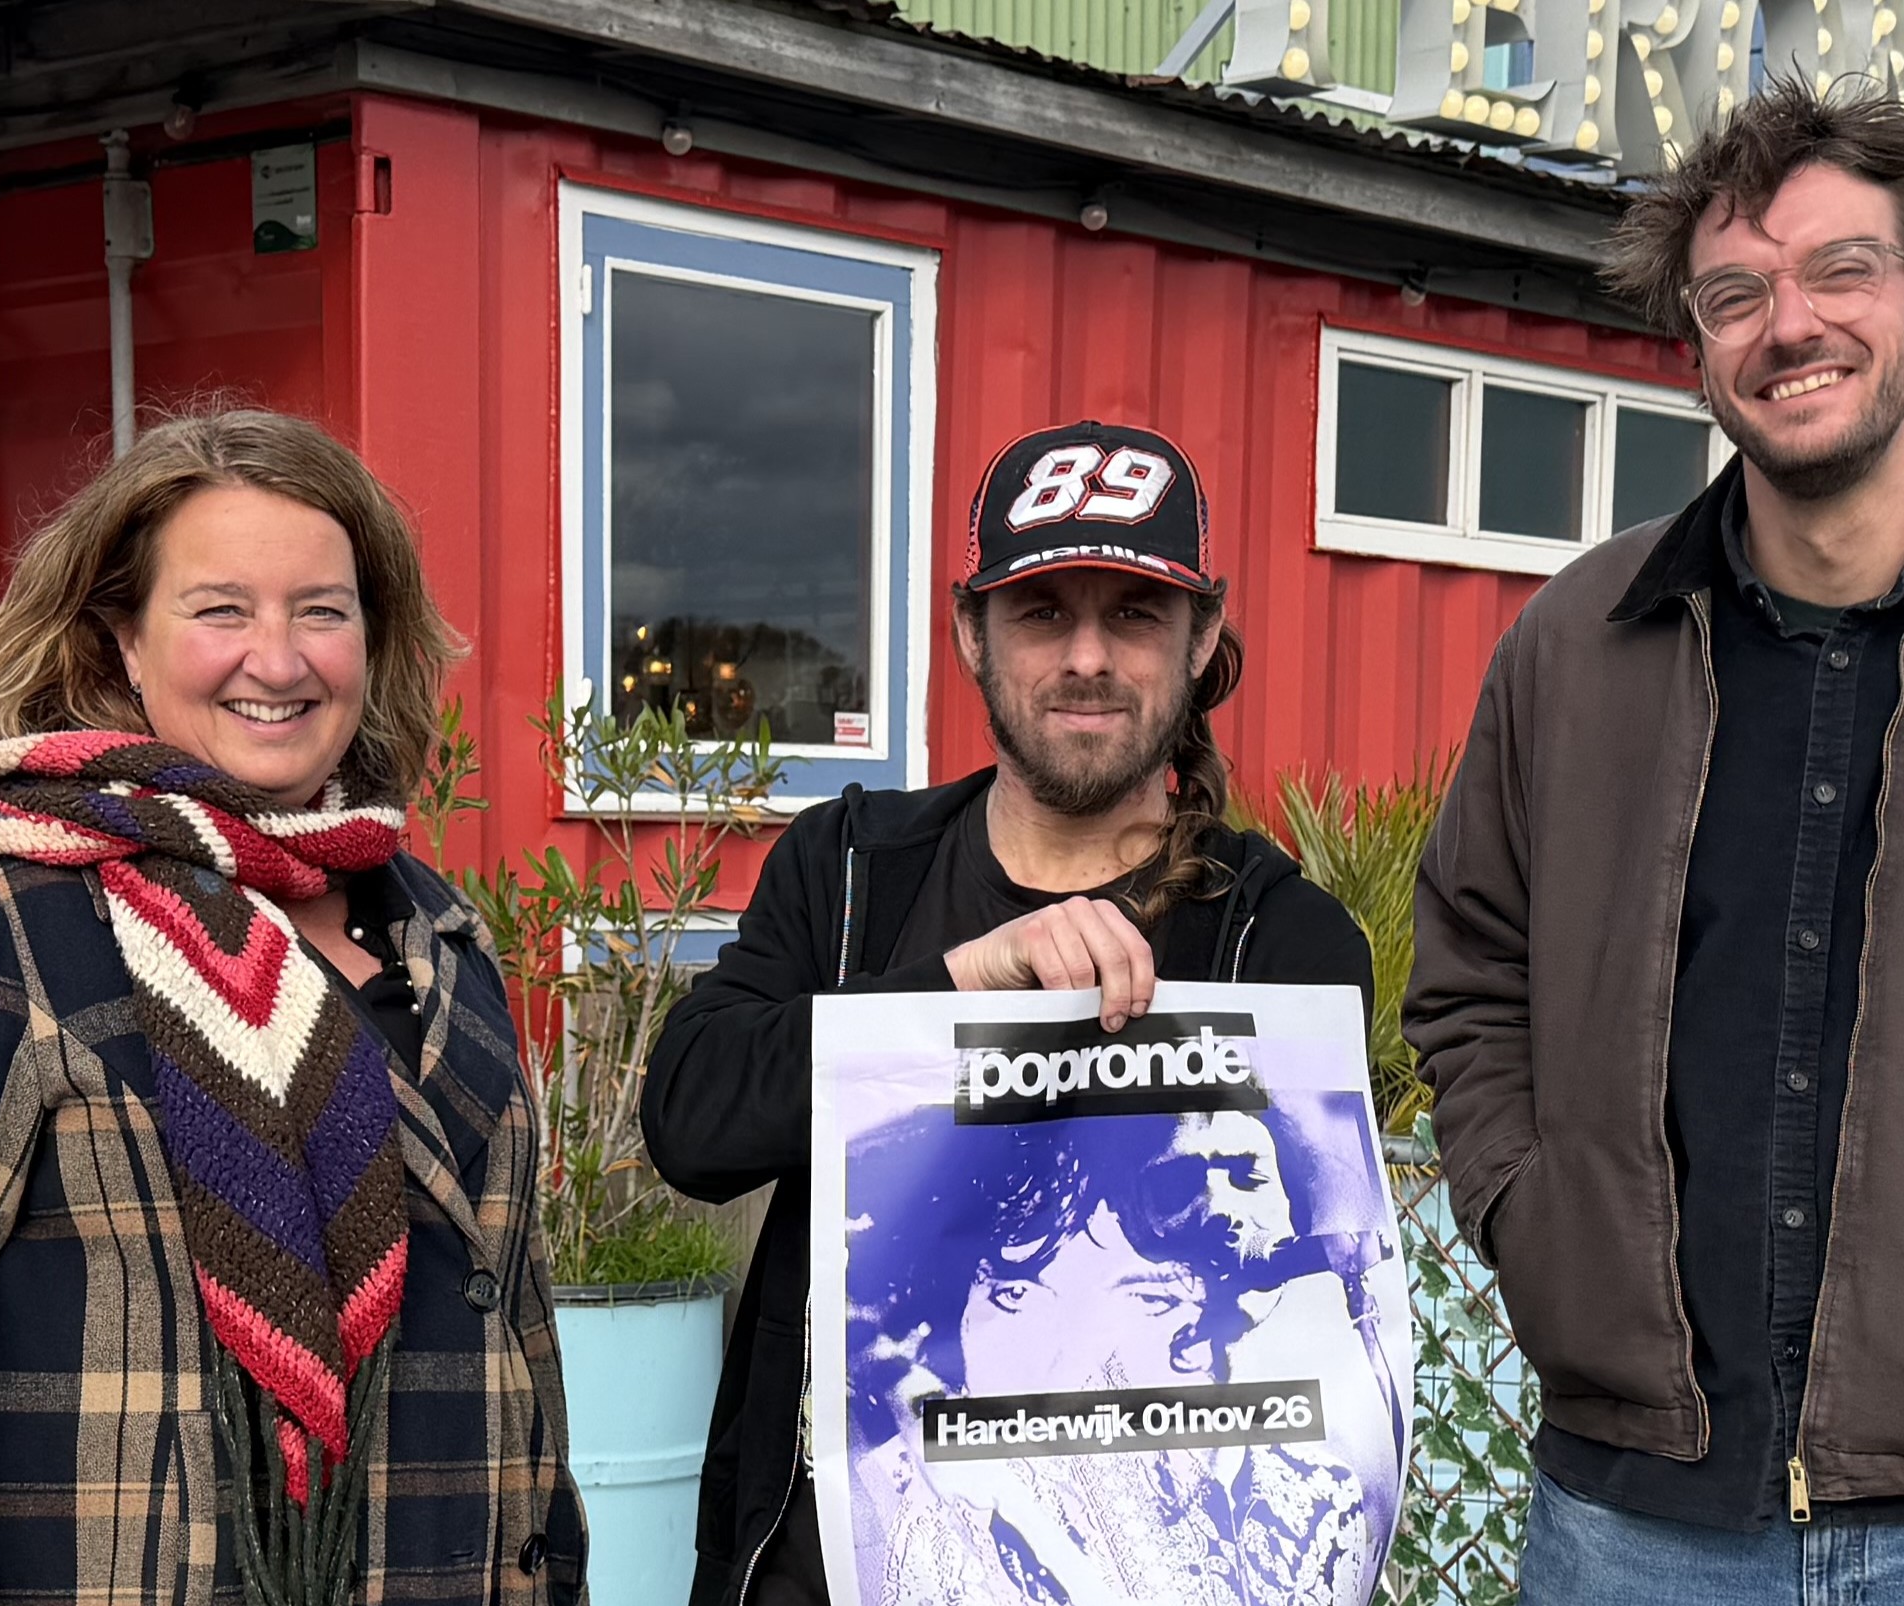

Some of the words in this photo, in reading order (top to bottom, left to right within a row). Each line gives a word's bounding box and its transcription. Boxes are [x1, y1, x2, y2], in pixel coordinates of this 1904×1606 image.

[1004, 443, 1176, 534] 89
[969, 1025, 1252, 1110] popronde
[936, 1403, 1137, 1447] Harderwijk
[1142, 1401, 1185, 1437] 01
[1189, 1403, 1256, 1435] nov
[1262, 1394, 1313, 1430] 26
